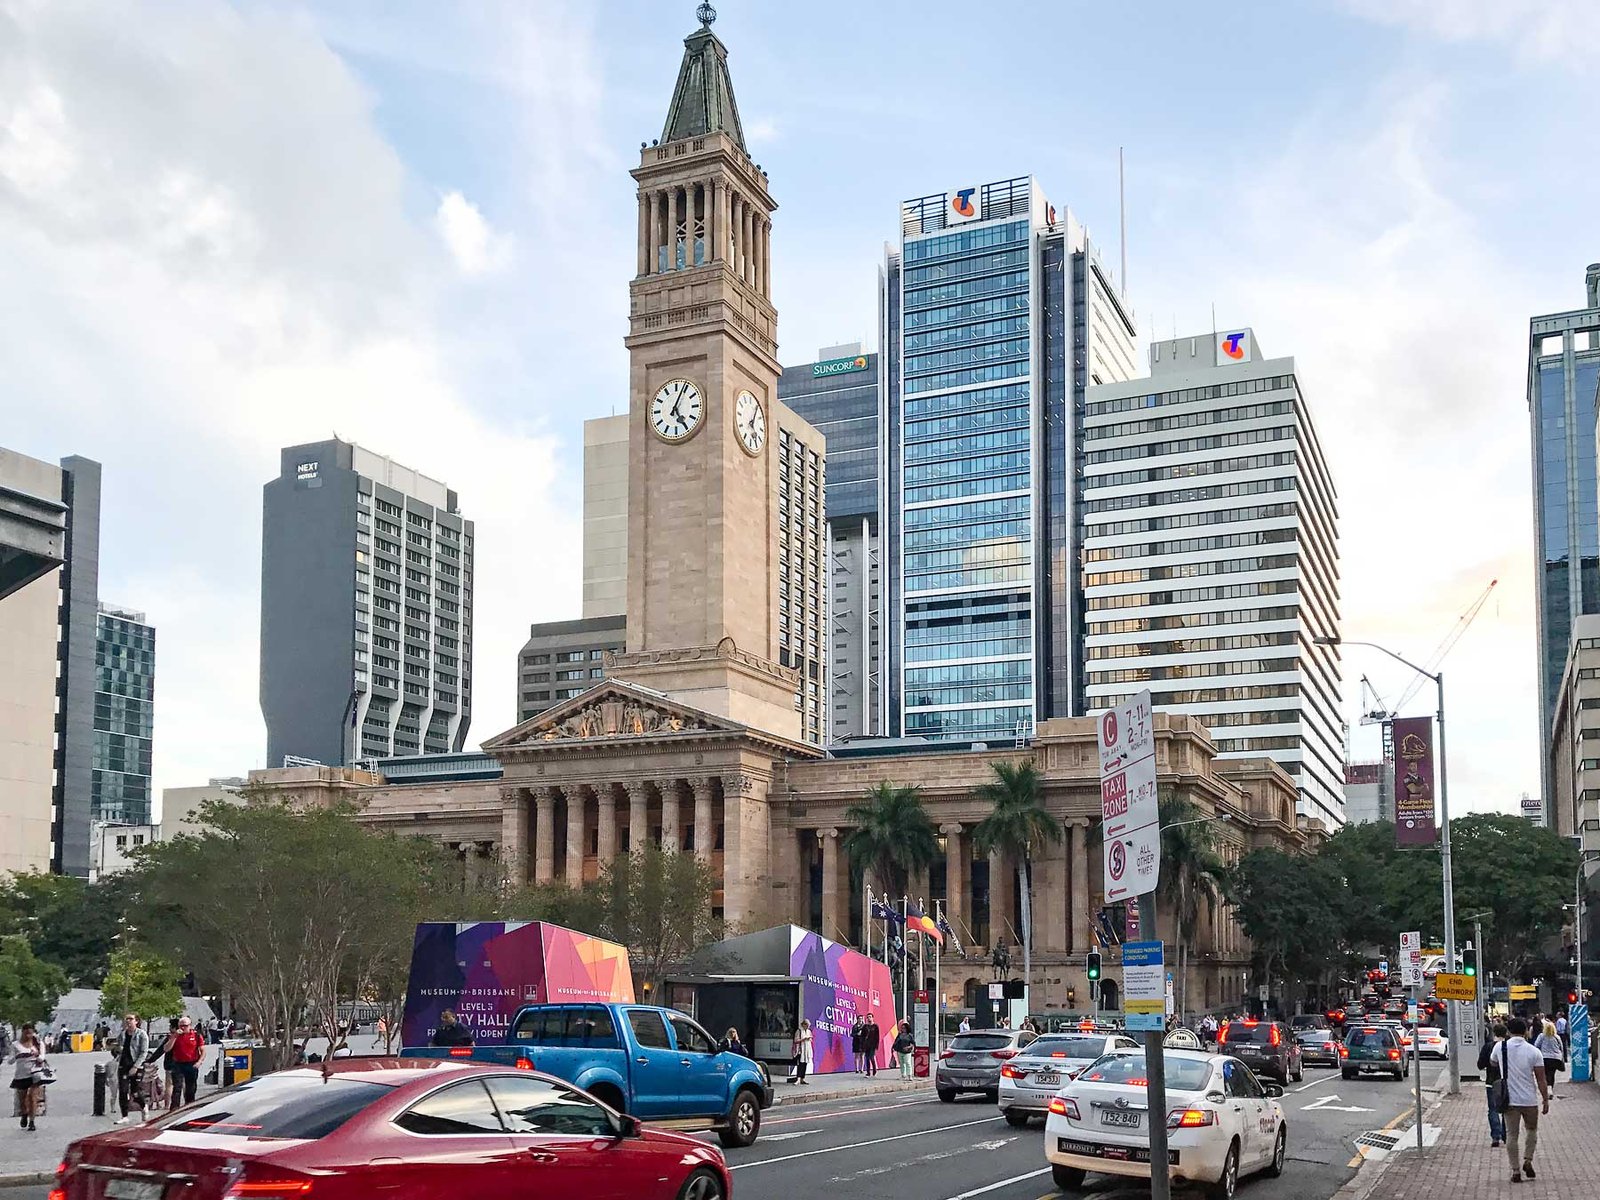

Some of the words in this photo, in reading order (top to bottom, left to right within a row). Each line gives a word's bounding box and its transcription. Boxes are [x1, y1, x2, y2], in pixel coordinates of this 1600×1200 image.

[813, 361, 854, 375] SUNCORP
[297, 462, 318, 472] NEXT
[297, 472, 317, 480] HOTELS
[1104, 775, 1125, 797] TAXI
[1104, 795, 1127, 818] ZONE
[1139, 844, 1151, 855] ALL
[1136, 853, 1154, 867] OTHER
[420, 988, 456, 996] MUSEUM
[472, 988, 516, 996] BRISBANE
[807, 974, 833, 988] MUSEUM
[841, 984, 868, 999] BRISBANE
[1437, 987, 1474, 996] ROADWORK
[461, 1003, 486, 1011] LEVEL
[836, 997, 852, 1010] LEVEL
[477, 1013, 510, 1026] HALL
[825, 1005, 845, 1022] CITY
[480, 1029, 504, 1038] OPEN
[815, 1019, 830, 1032] FREE
[830, 1023, 847, 1036] ENTRY
